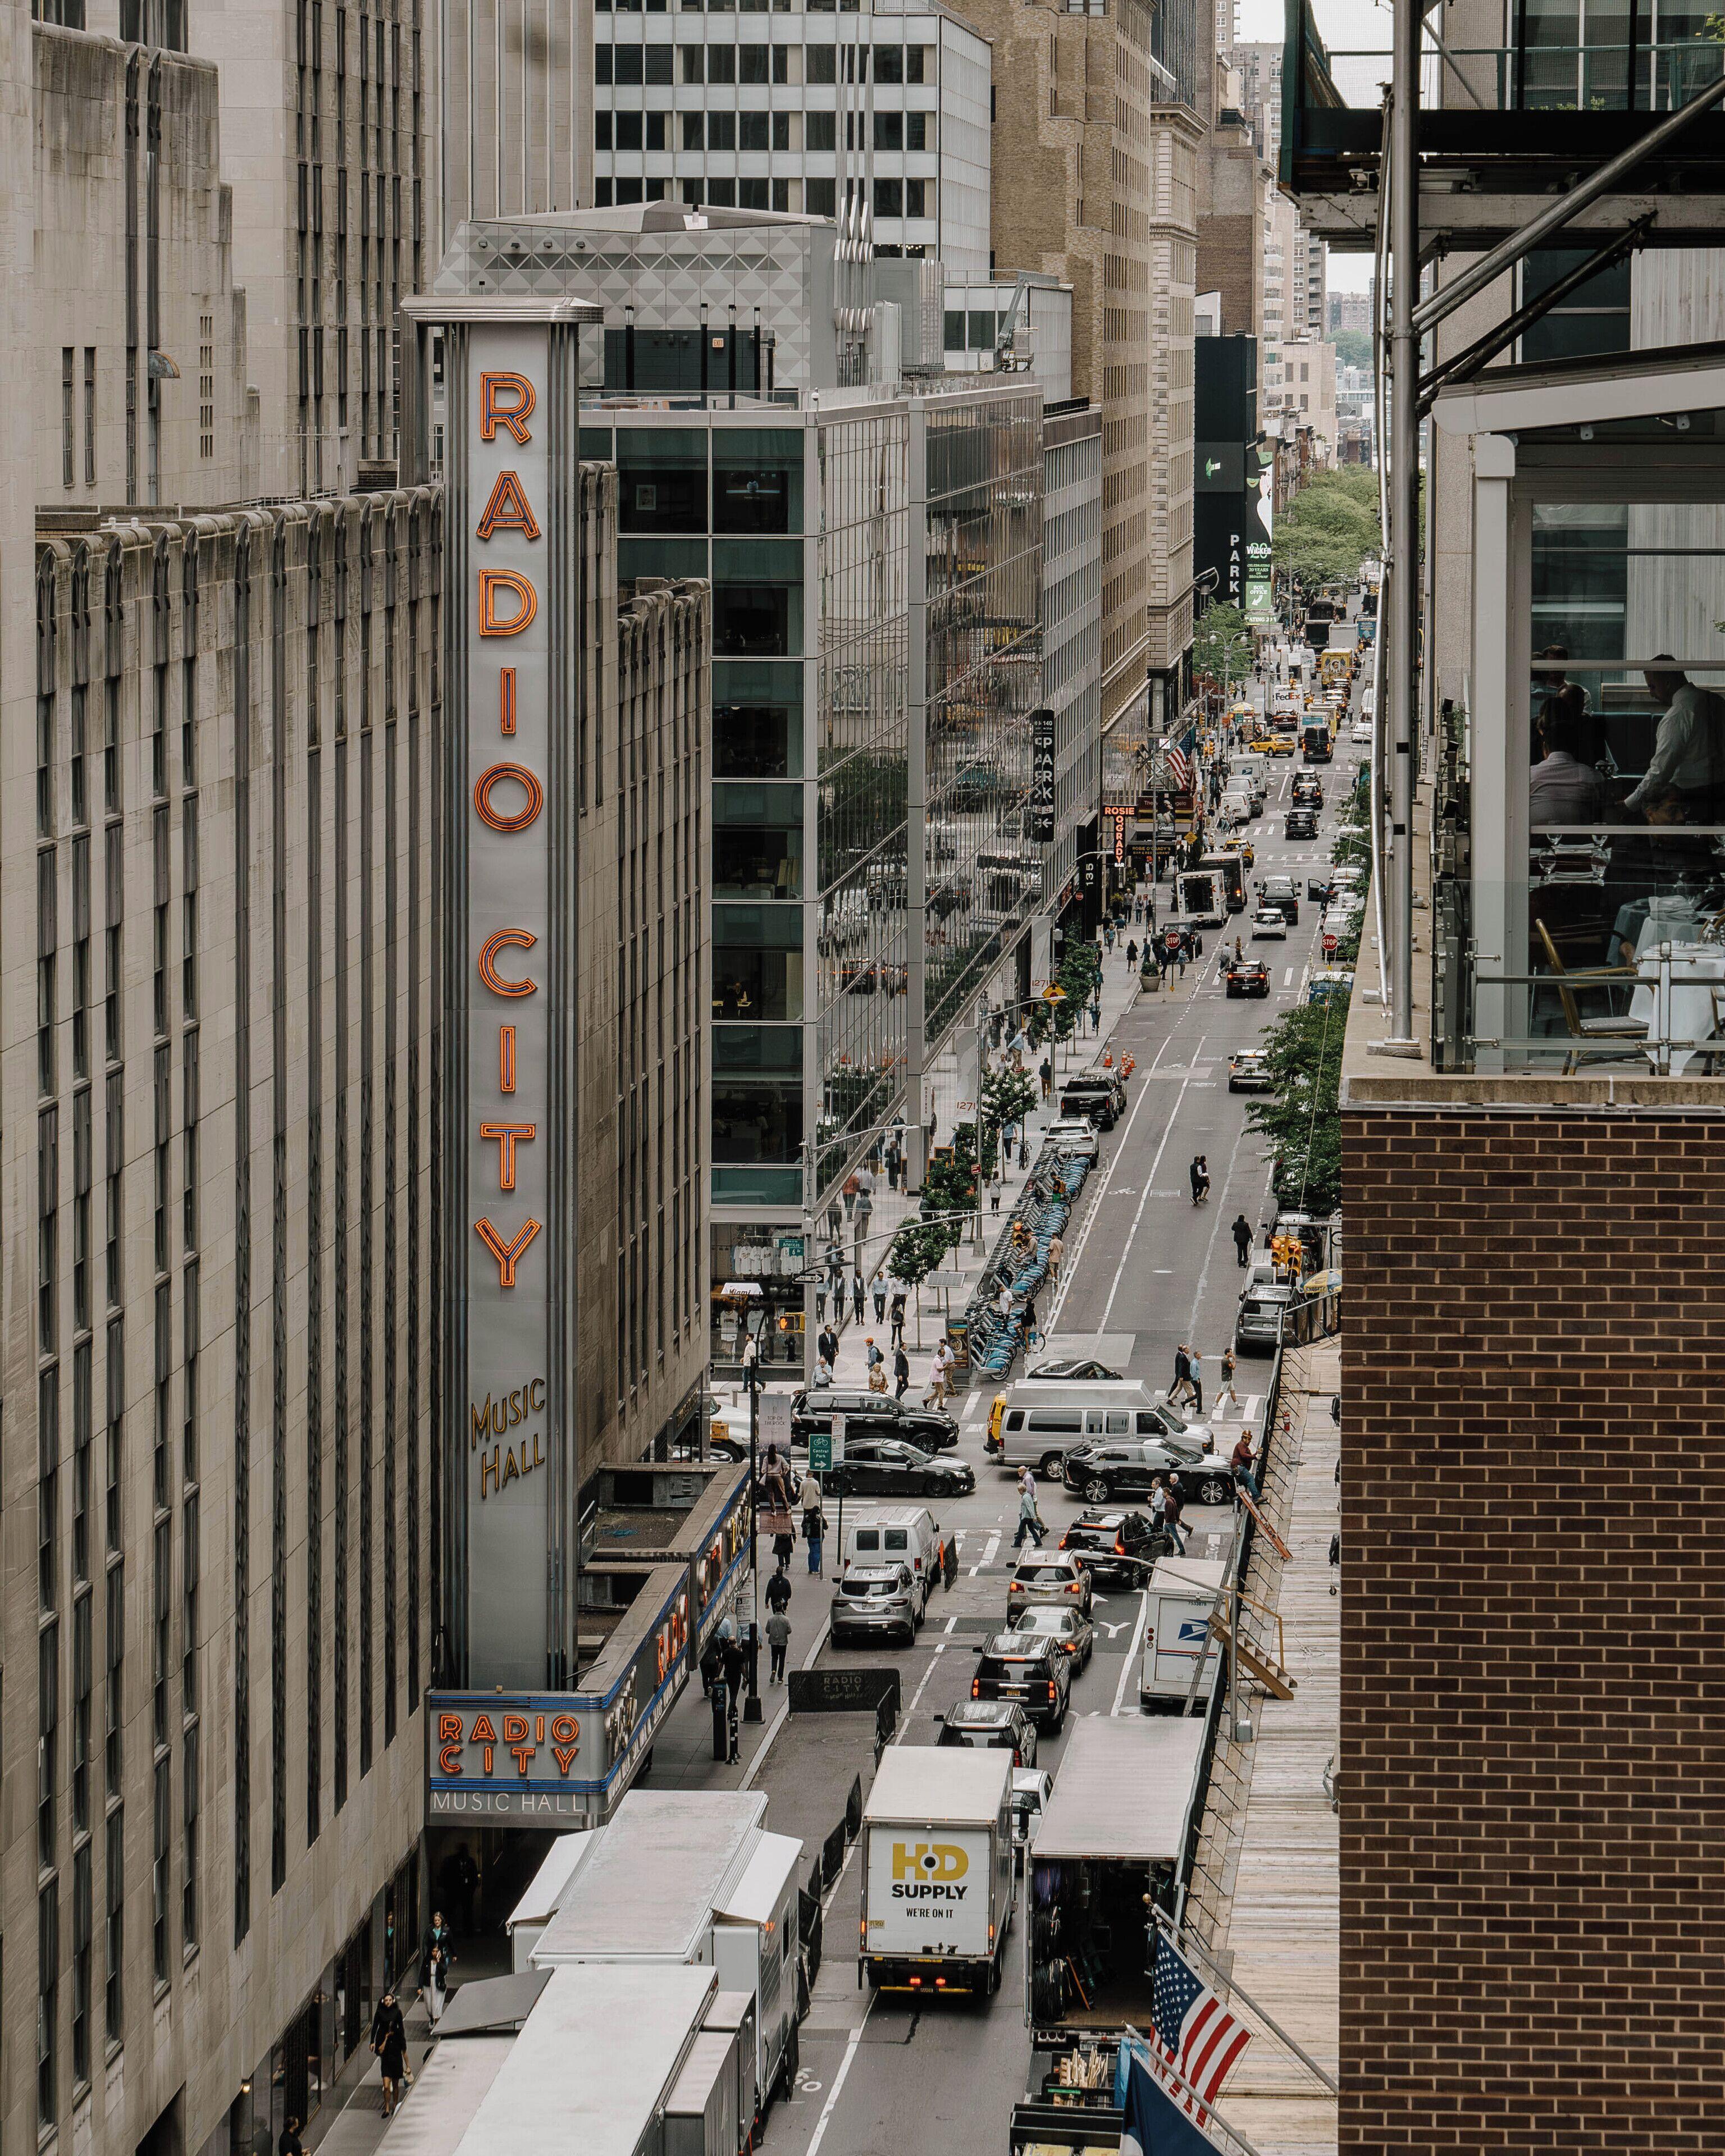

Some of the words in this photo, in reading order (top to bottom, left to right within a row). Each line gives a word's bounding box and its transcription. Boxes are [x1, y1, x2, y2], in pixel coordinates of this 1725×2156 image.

[1229, 534, 1240, 593] PARK
[474, 372, 543, 832] RADIO
[1275, 692, 1301, 701] FedEx
[1042, 737, 1053, 799] PARK
[1085, 863, 1094, 886] 135
[474, 928, 543, 1287] CITY
[956, 1102, 976, 1111] 1271
[482, 1432, 545, 1500] HALL
[439, 1714, 580, 1744] RADIO
[439, 1744, 580, 1775] CITY
[433, 1792, 509, 1811] MUSIC
[522, 1793, 584, 1812] HALL
[892, 1843, 969, 1881] HD
[892, 1884, 968, 1900] SUPPLY
[906, 1908, 930, 1918] WE'RE
[932, 1908, 943, 1919] ON
[946, 1909, 953, 1919] IT
